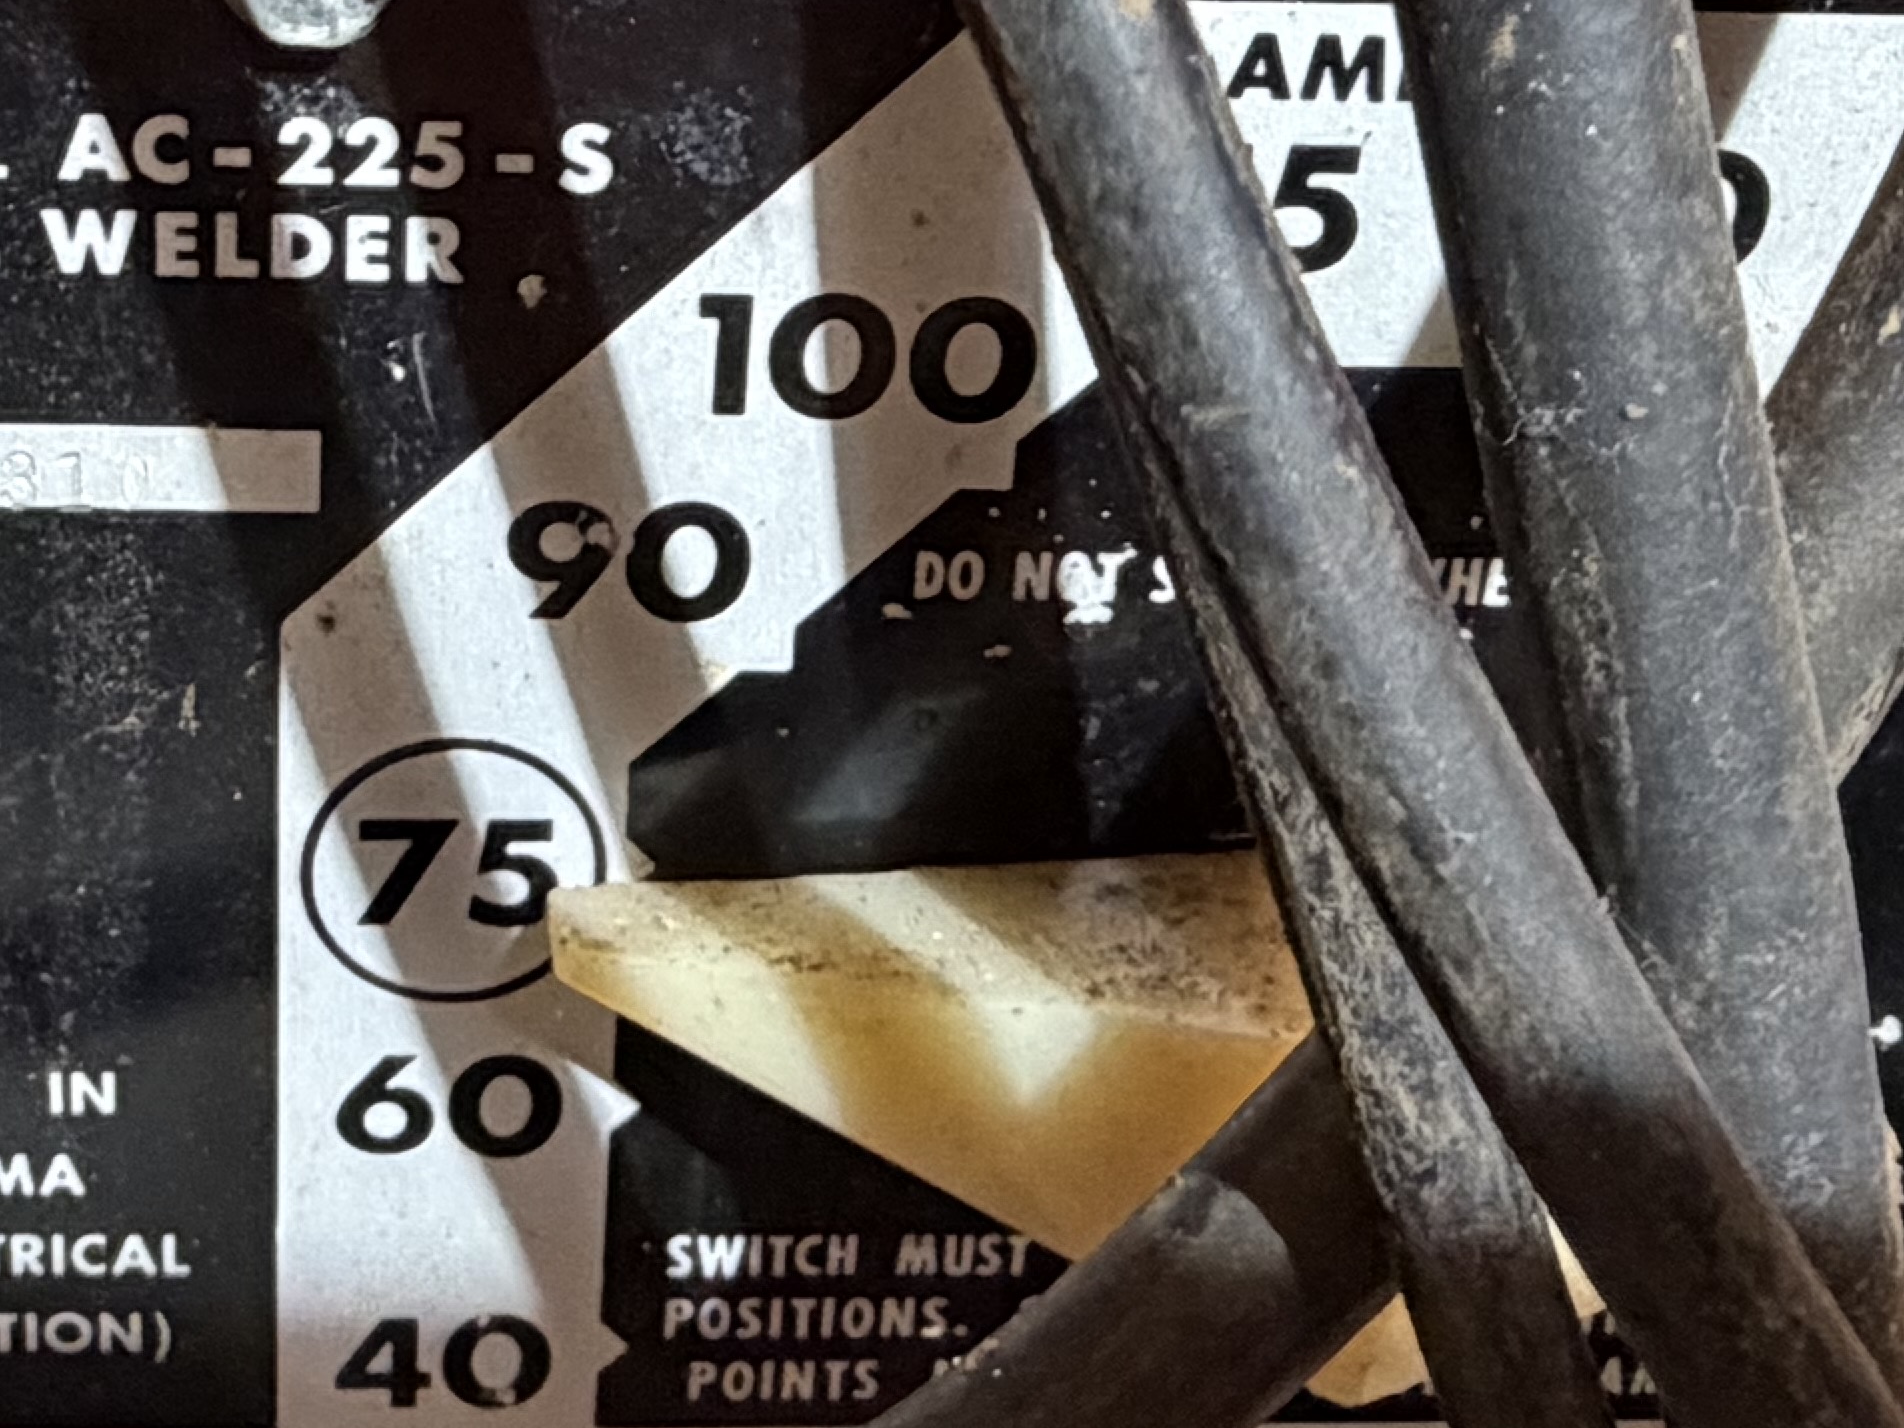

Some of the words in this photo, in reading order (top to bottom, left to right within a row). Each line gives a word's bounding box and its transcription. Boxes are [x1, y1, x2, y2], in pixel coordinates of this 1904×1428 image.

[40, 208, 460, 283] WELDER
[699, 292, 1038, 424] 100
[507, 500, 751, 623] 90
[914, 551, 984, 599] DO
[357, 819, 559, 927] 75
[48, 1071, 116, 1115] IN
[335, 1055, 563, 1158] 60
[667, 1235, 858, 1278] SWITCH
[891, 1227, 1036, 1280] MUST
[665, 1298, 965, 1338] POSITIONS.
[335, 1314, 552, 1408] 40
[688, 1360, 877, 1400] POINTS
